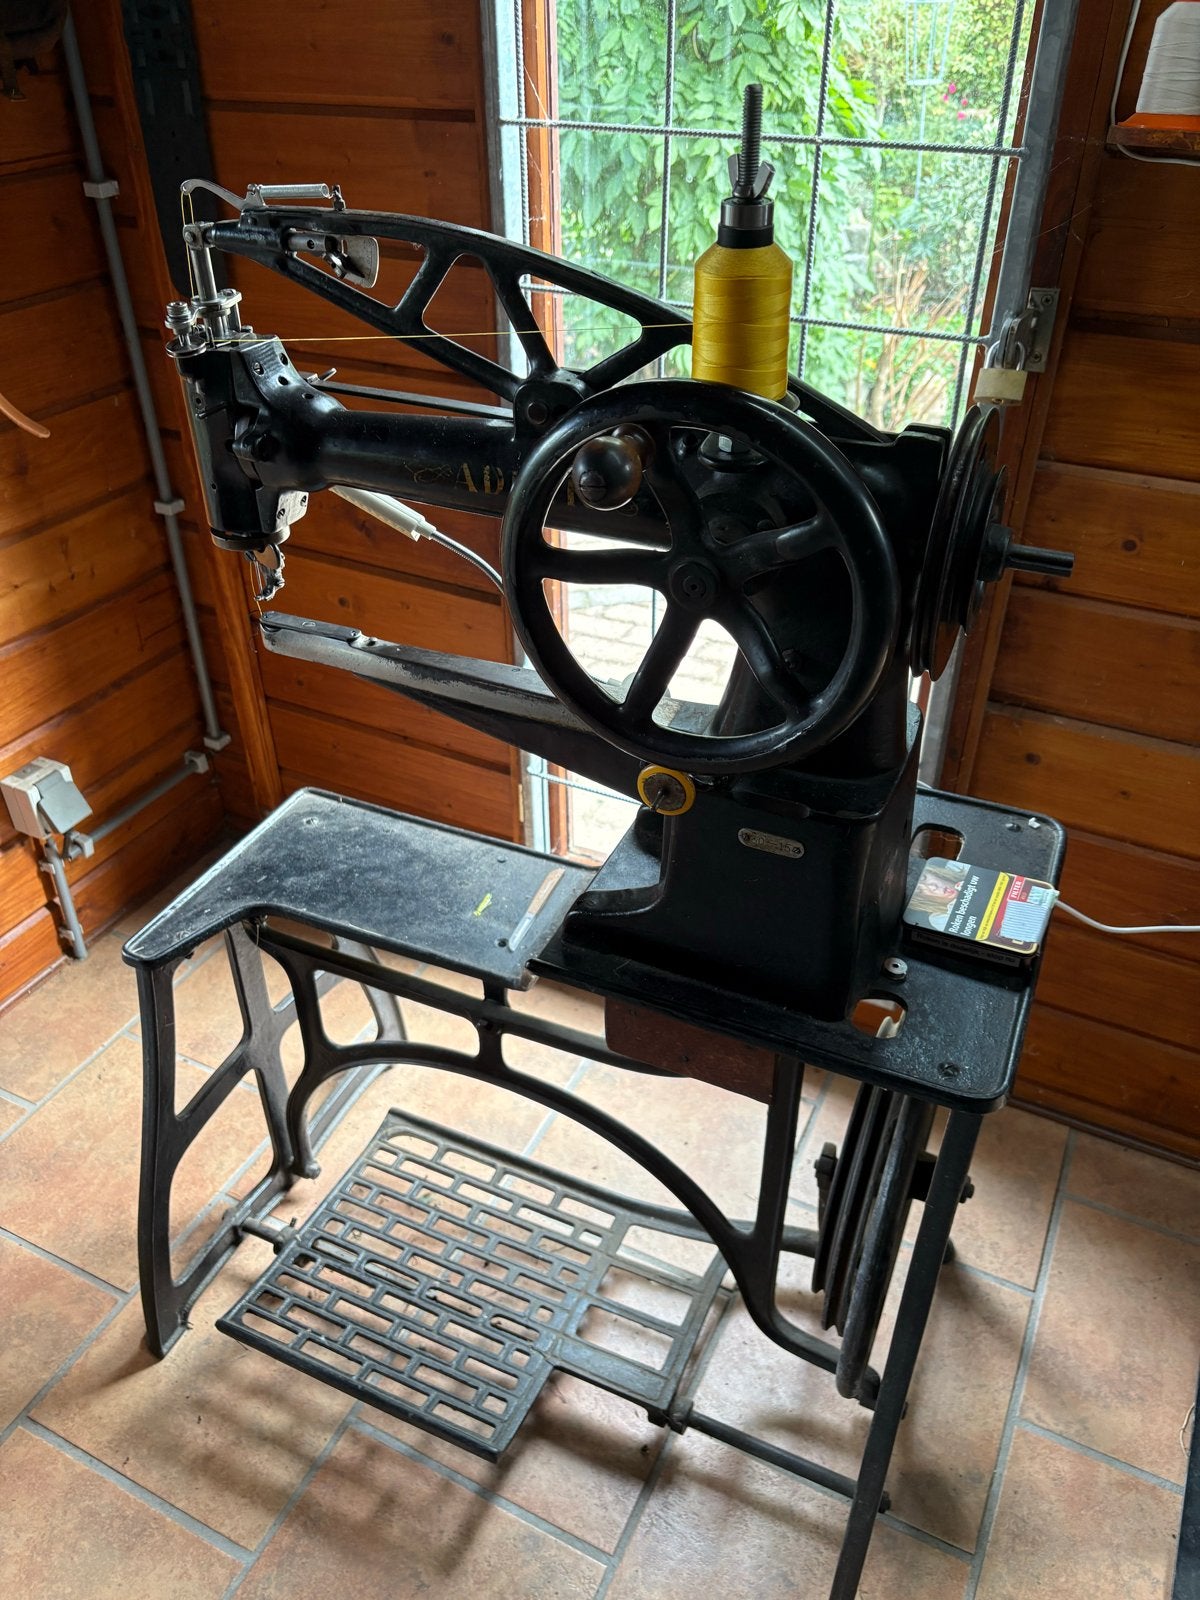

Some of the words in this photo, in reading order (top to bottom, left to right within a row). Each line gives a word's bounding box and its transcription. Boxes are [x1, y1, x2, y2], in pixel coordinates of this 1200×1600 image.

[970, 875, 980, 885] uw
[1011, 881, 1022, 898] FILTER
[955, 884, 977, 915] beschadigt
[948, 914, 964, 934] Roken
[960, 915, 977, 937] longen
